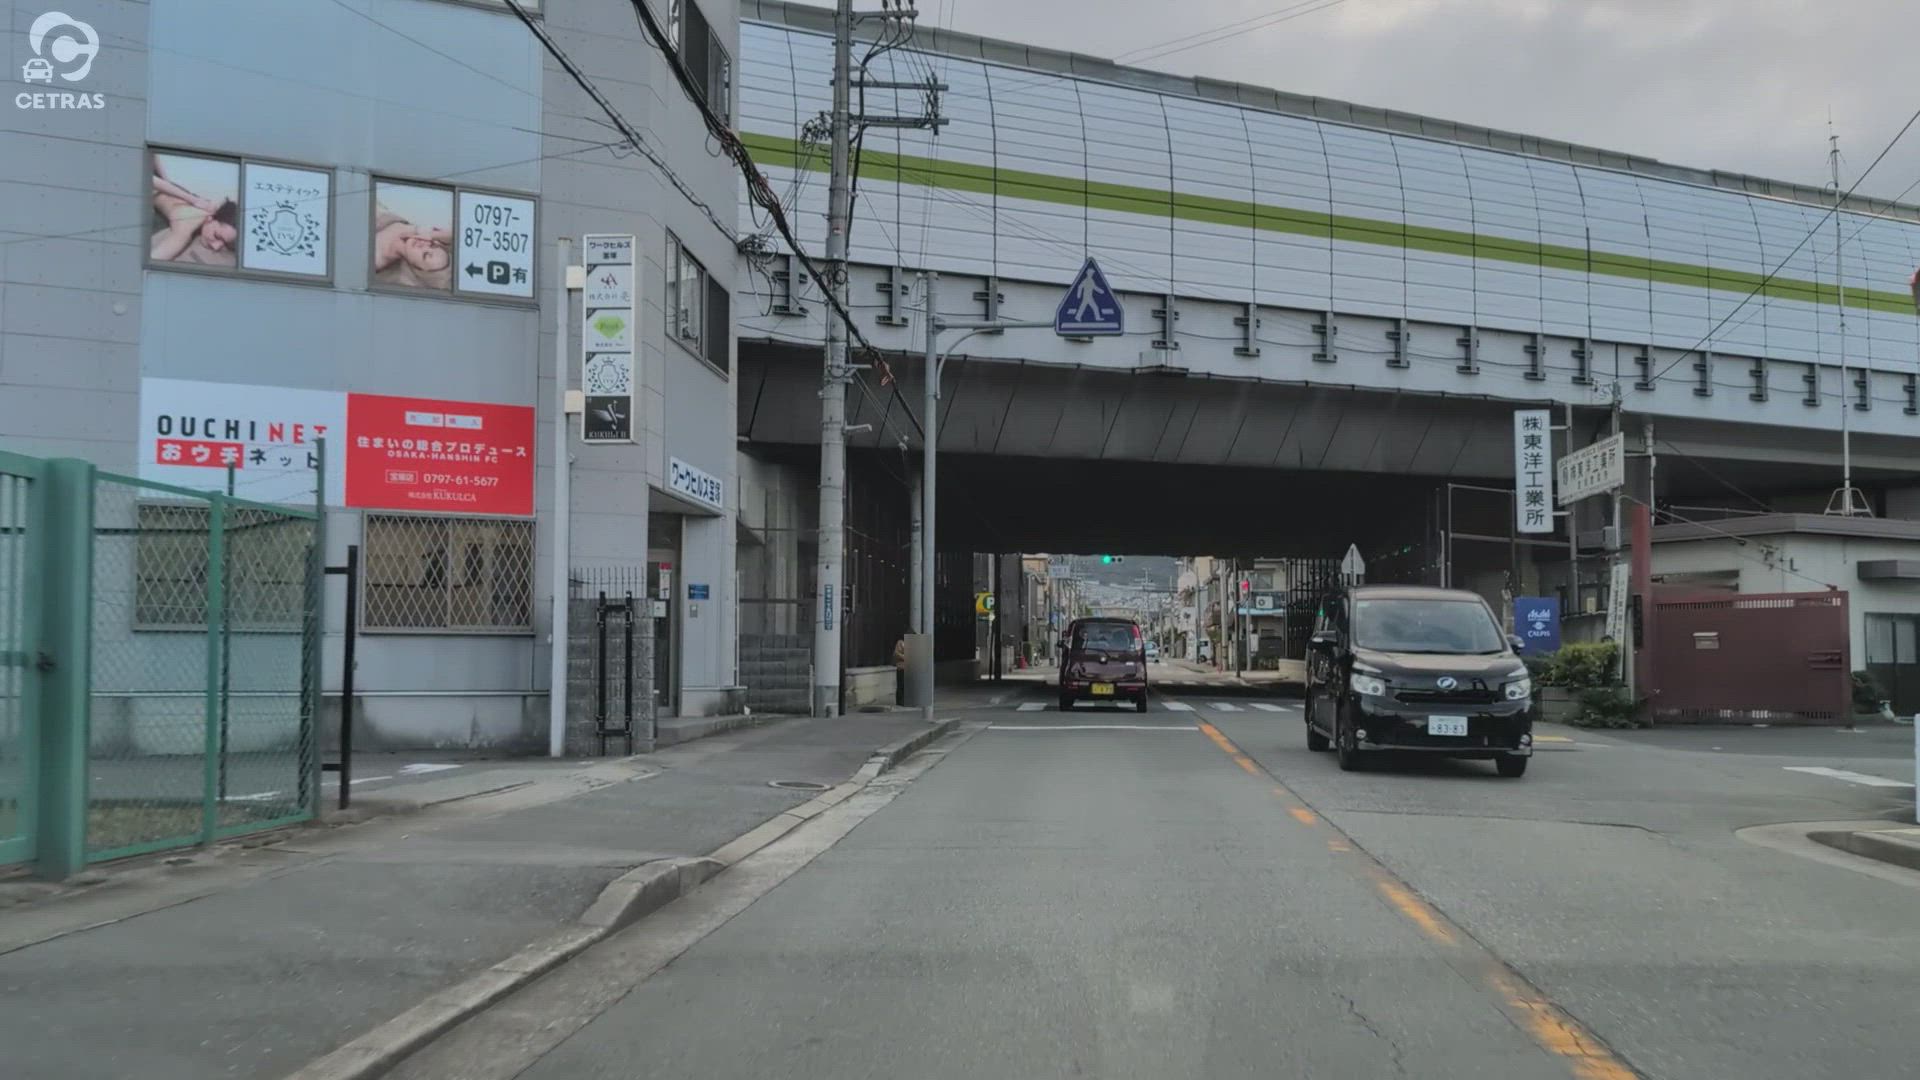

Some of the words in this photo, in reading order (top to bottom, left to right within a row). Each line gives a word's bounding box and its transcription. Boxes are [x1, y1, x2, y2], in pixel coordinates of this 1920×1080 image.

[474, 204, 521, 228] 0797-
[464, 228, 529, 254] 87-3507
[589, 242, 631, 250] ワークヒルズ
[157, 414, 257, 441] OUCHI
[356, 436, 527, 457] 住まいの総合プロデュース
[423, 474, 499, 487] 0797-61-5677
